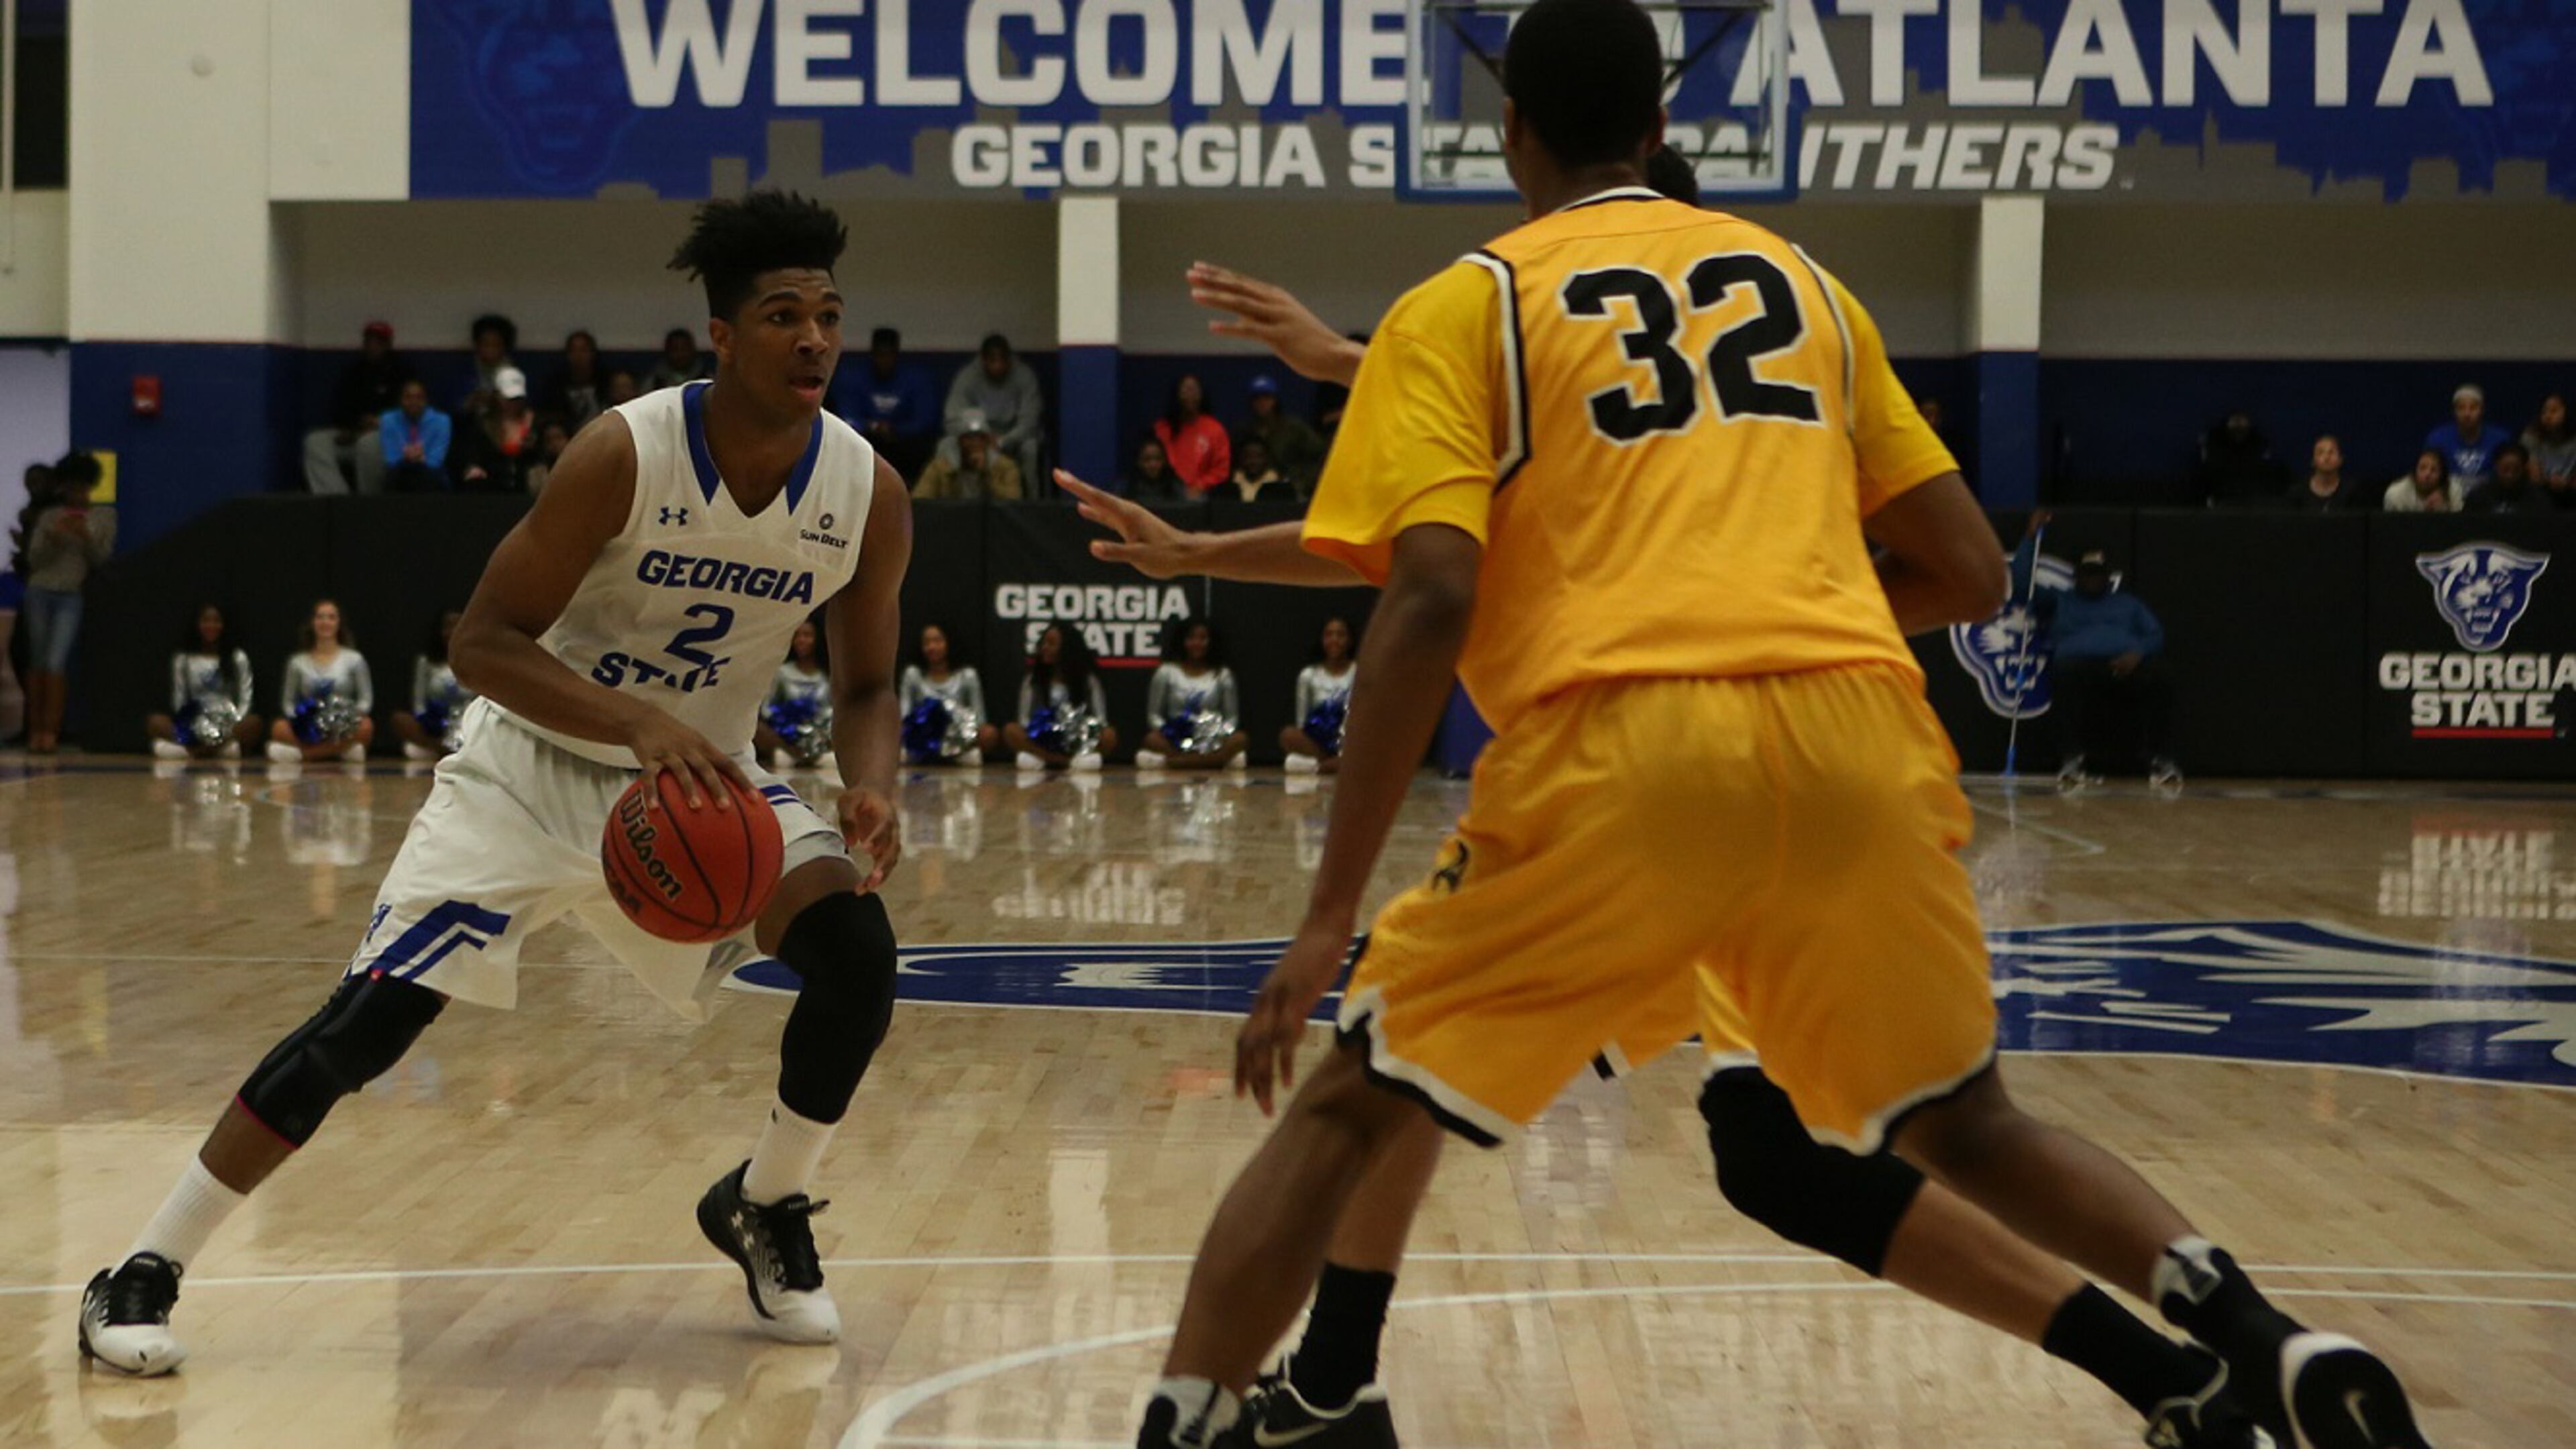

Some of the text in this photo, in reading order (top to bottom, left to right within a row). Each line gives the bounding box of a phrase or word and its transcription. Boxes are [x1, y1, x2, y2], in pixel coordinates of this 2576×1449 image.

[610, 0, 1430, 107] WELCOME
[1729, 0, 2494, 107] ATLANTA
[952, 124, 1326, 188] GEORGIA
[1560, 251, 1825, 446] 32
[637, 549, 814, 604] GEORGIA
[996, 584, 1190, 621] GEORGIA
[663, 604, 735, 666] 2
[1025, 622, 1162, 656] SATE
[2379, 653, 2576, 691] GEORGIA
[2412, 692, 2555, 727] STATE
[620, 786, 683, 900] Wilson
